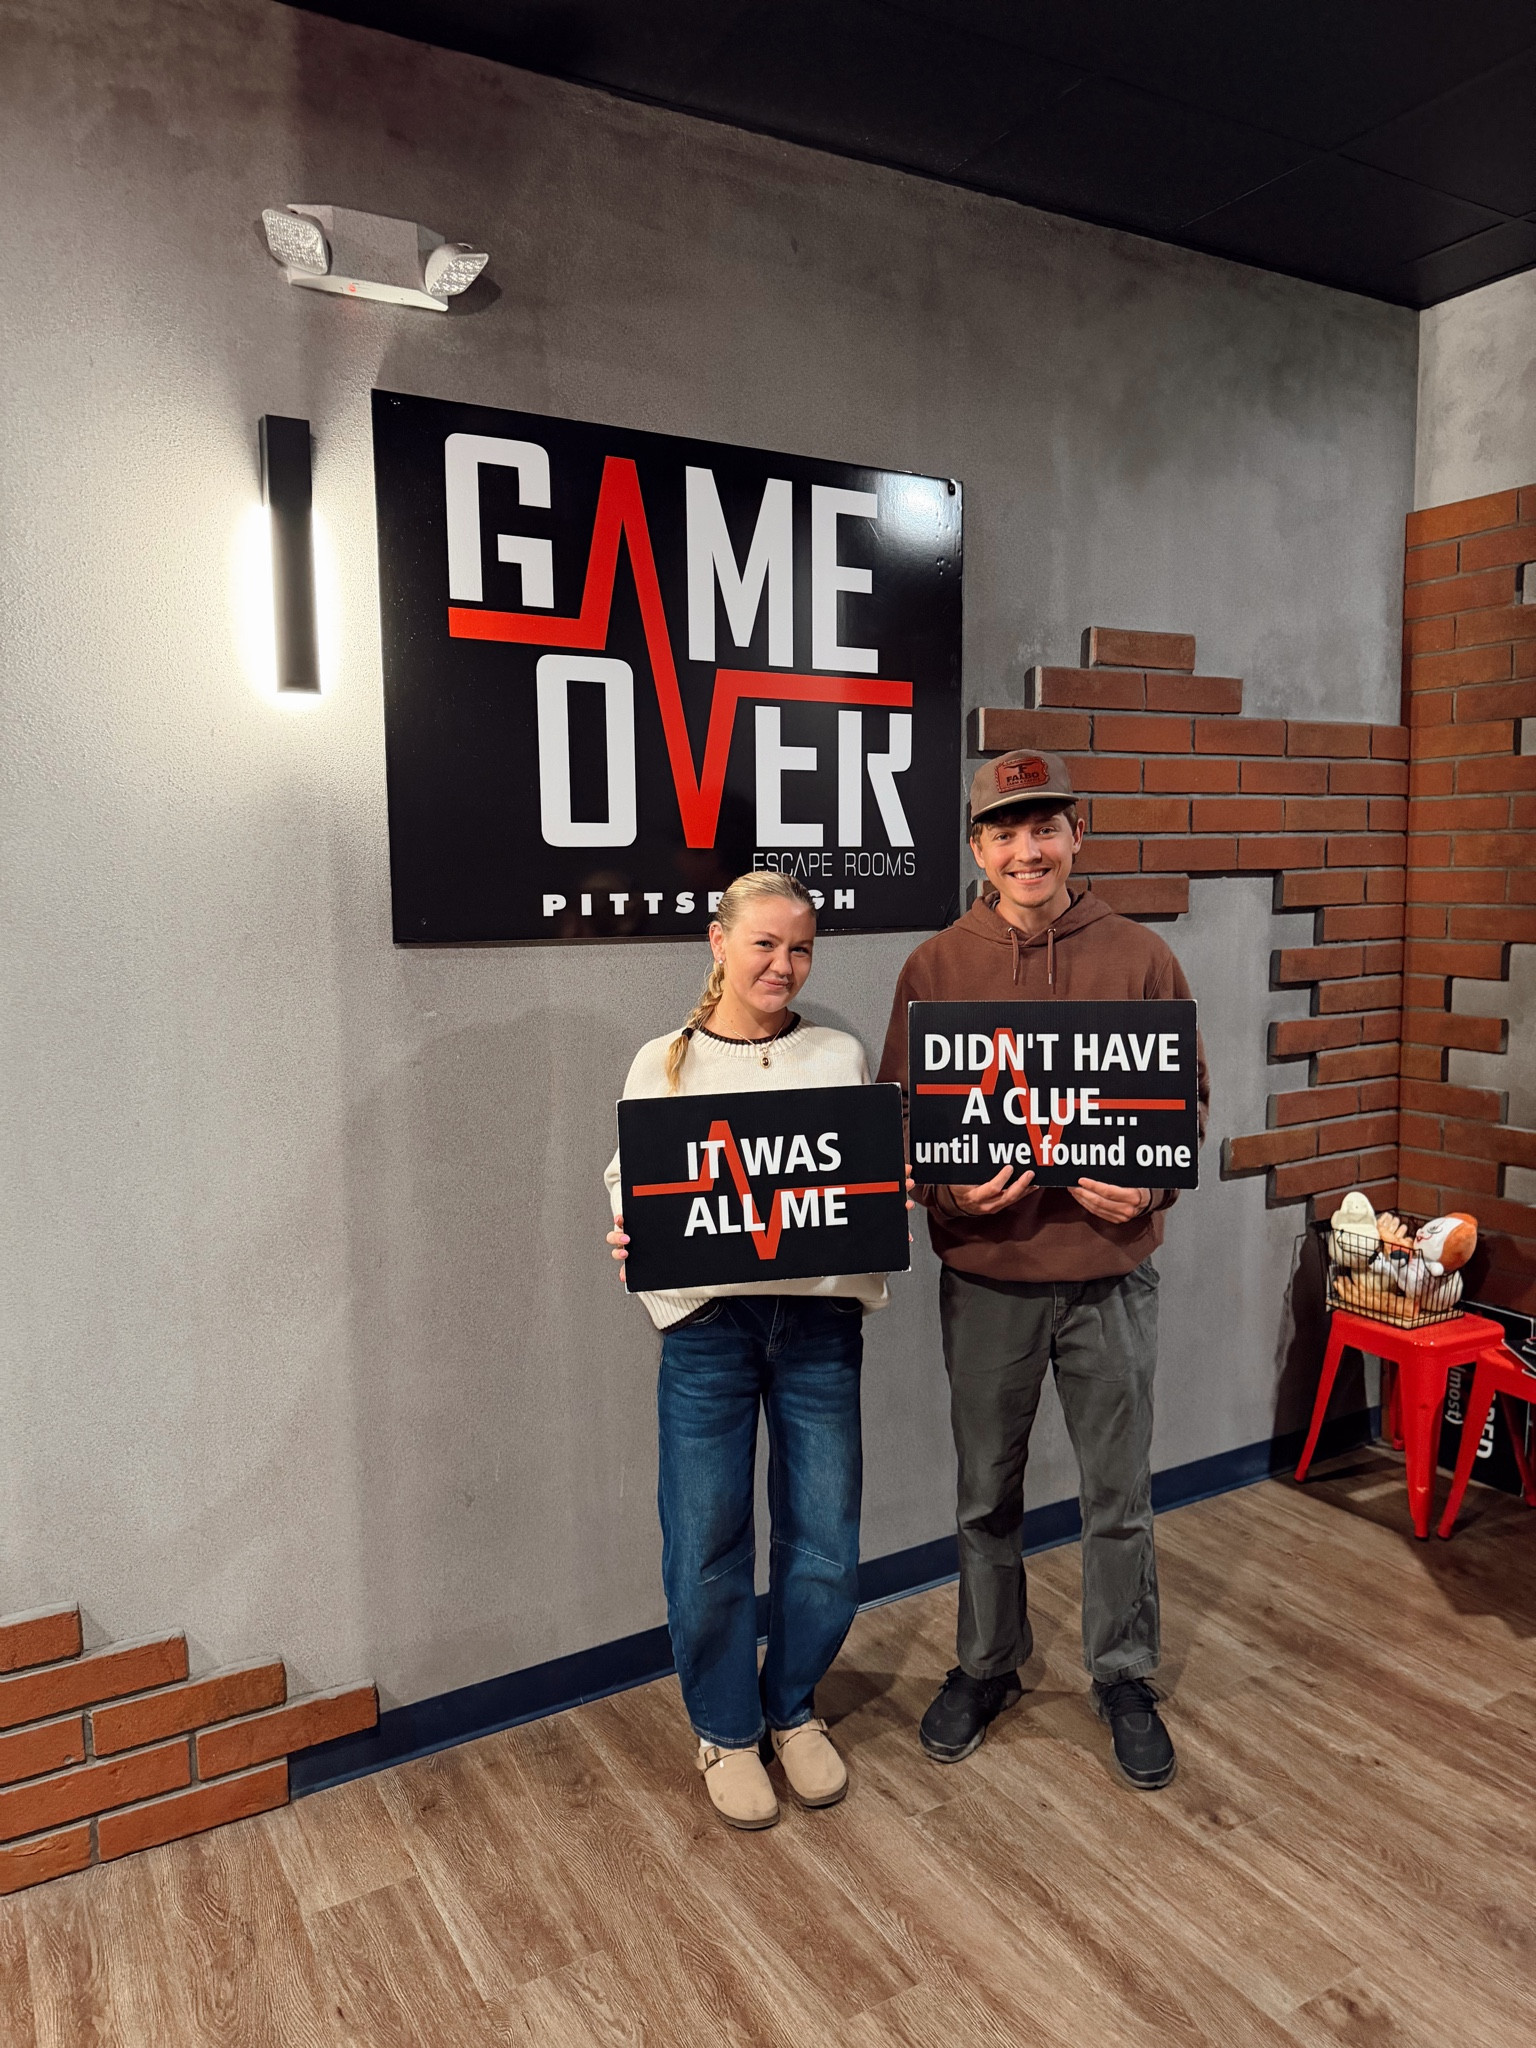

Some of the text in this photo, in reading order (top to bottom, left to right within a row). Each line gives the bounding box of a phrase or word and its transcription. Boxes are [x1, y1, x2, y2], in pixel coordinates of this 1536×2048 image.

[445, 432, 879, 674] GAME
[536, 653, 915, 849] OVER
[752, 852, 916, 877] ESCAPE ROOMS
[543, 888, 855, 917] PITTSBGH
[924, 1033, 1180, 1072] DIDN'T HAVE
[961, 1086, 1138, 1126] A CLUE...
[687, 1132, 842, 1180] IT WAS
[915, 1134, 1192, 1168] until we found one
[684, 1187, 848, 1237] ALL ME
